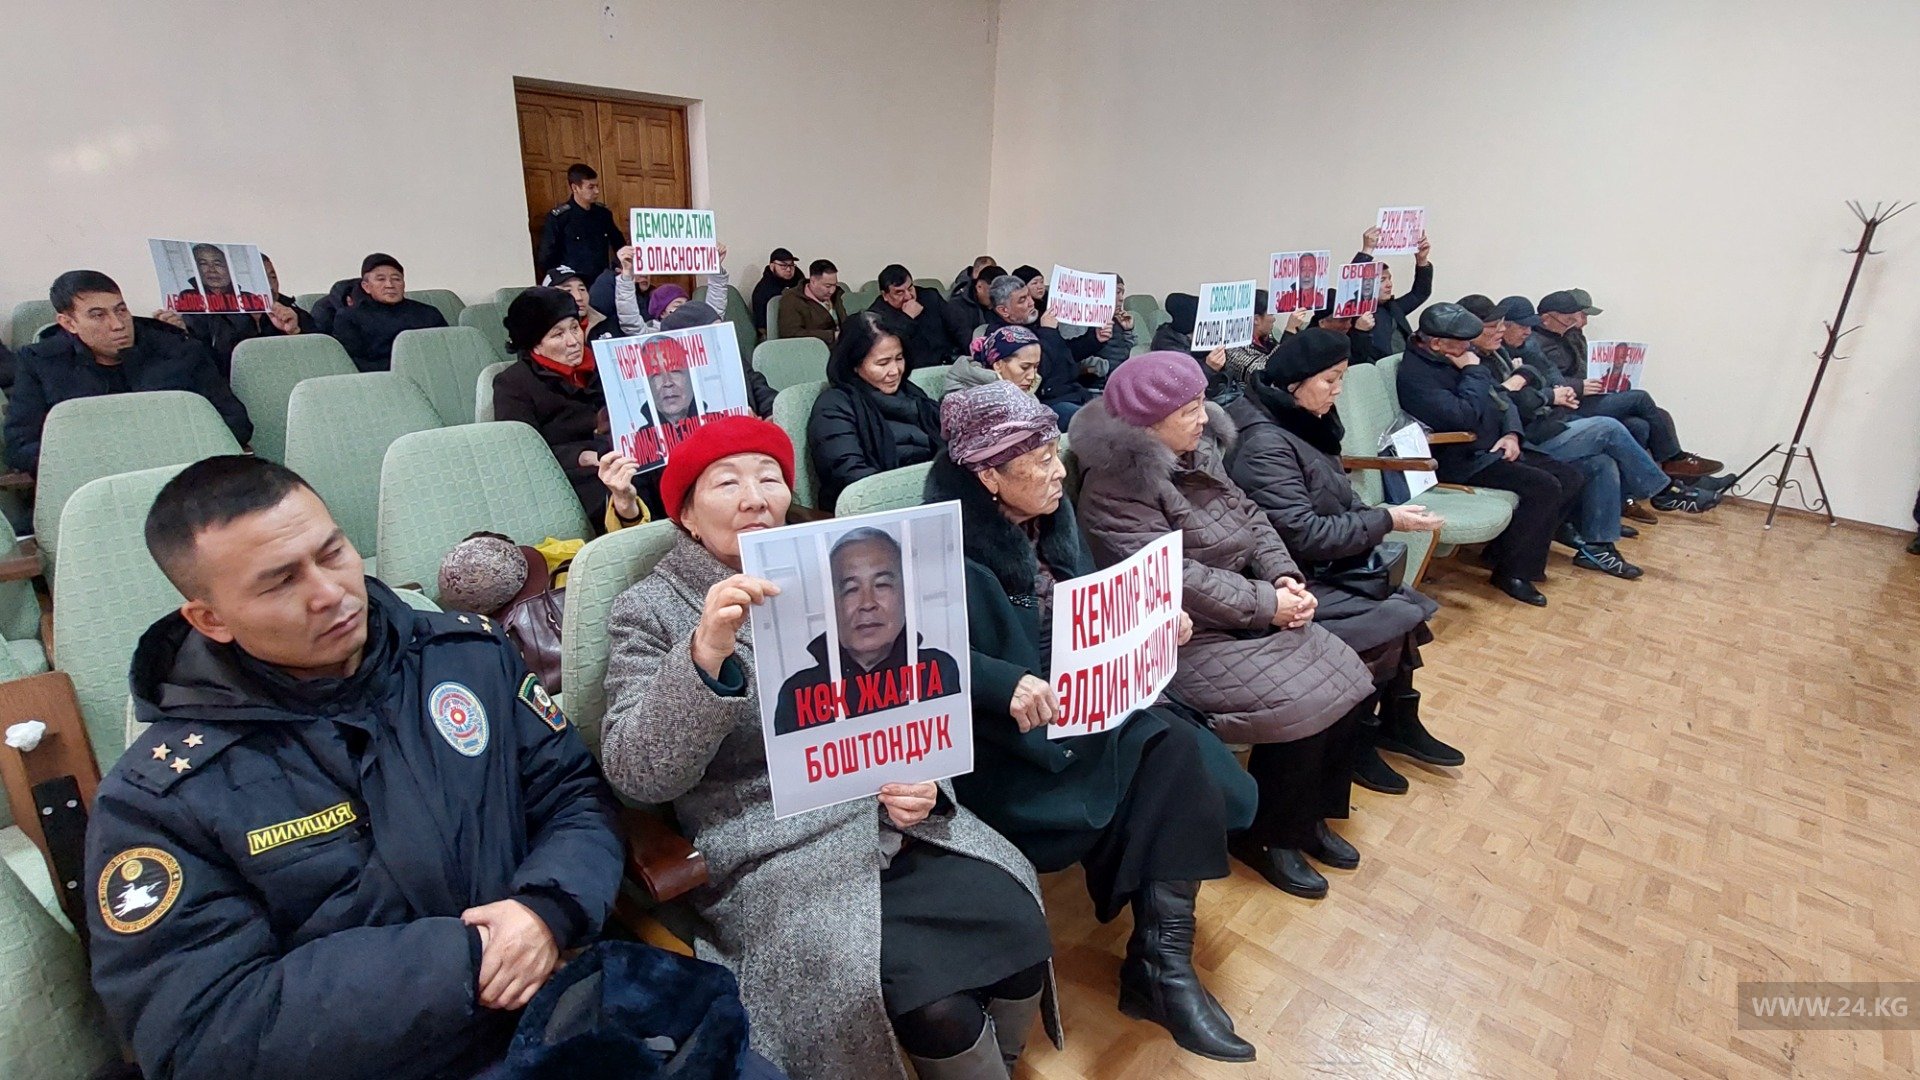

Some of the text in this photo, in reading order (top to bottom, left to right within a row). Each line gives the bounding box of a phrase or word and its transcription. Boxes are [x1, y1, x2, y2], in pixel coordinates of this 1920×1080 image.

[636, 212, 713, 242] ДЕМОКРАТИЯ
[635, 246, 718, 272] В ОПАСНОСТИ!
[1210, 284, 1237, 315] СВОБОДА
[1195, 319, 1224, 346] ОСНОВА
[1071, 546, 1172, 651] КЕМПИР АБАД
[794, 659, 943, 727] КӨК ЖАЛГА
[1056, 653, 1129, 732] ЭЛДИН
[804, 713, 953, 784] БОШТОНДУК
[252, 806, 351, 850] МИЛИЦИЯ
